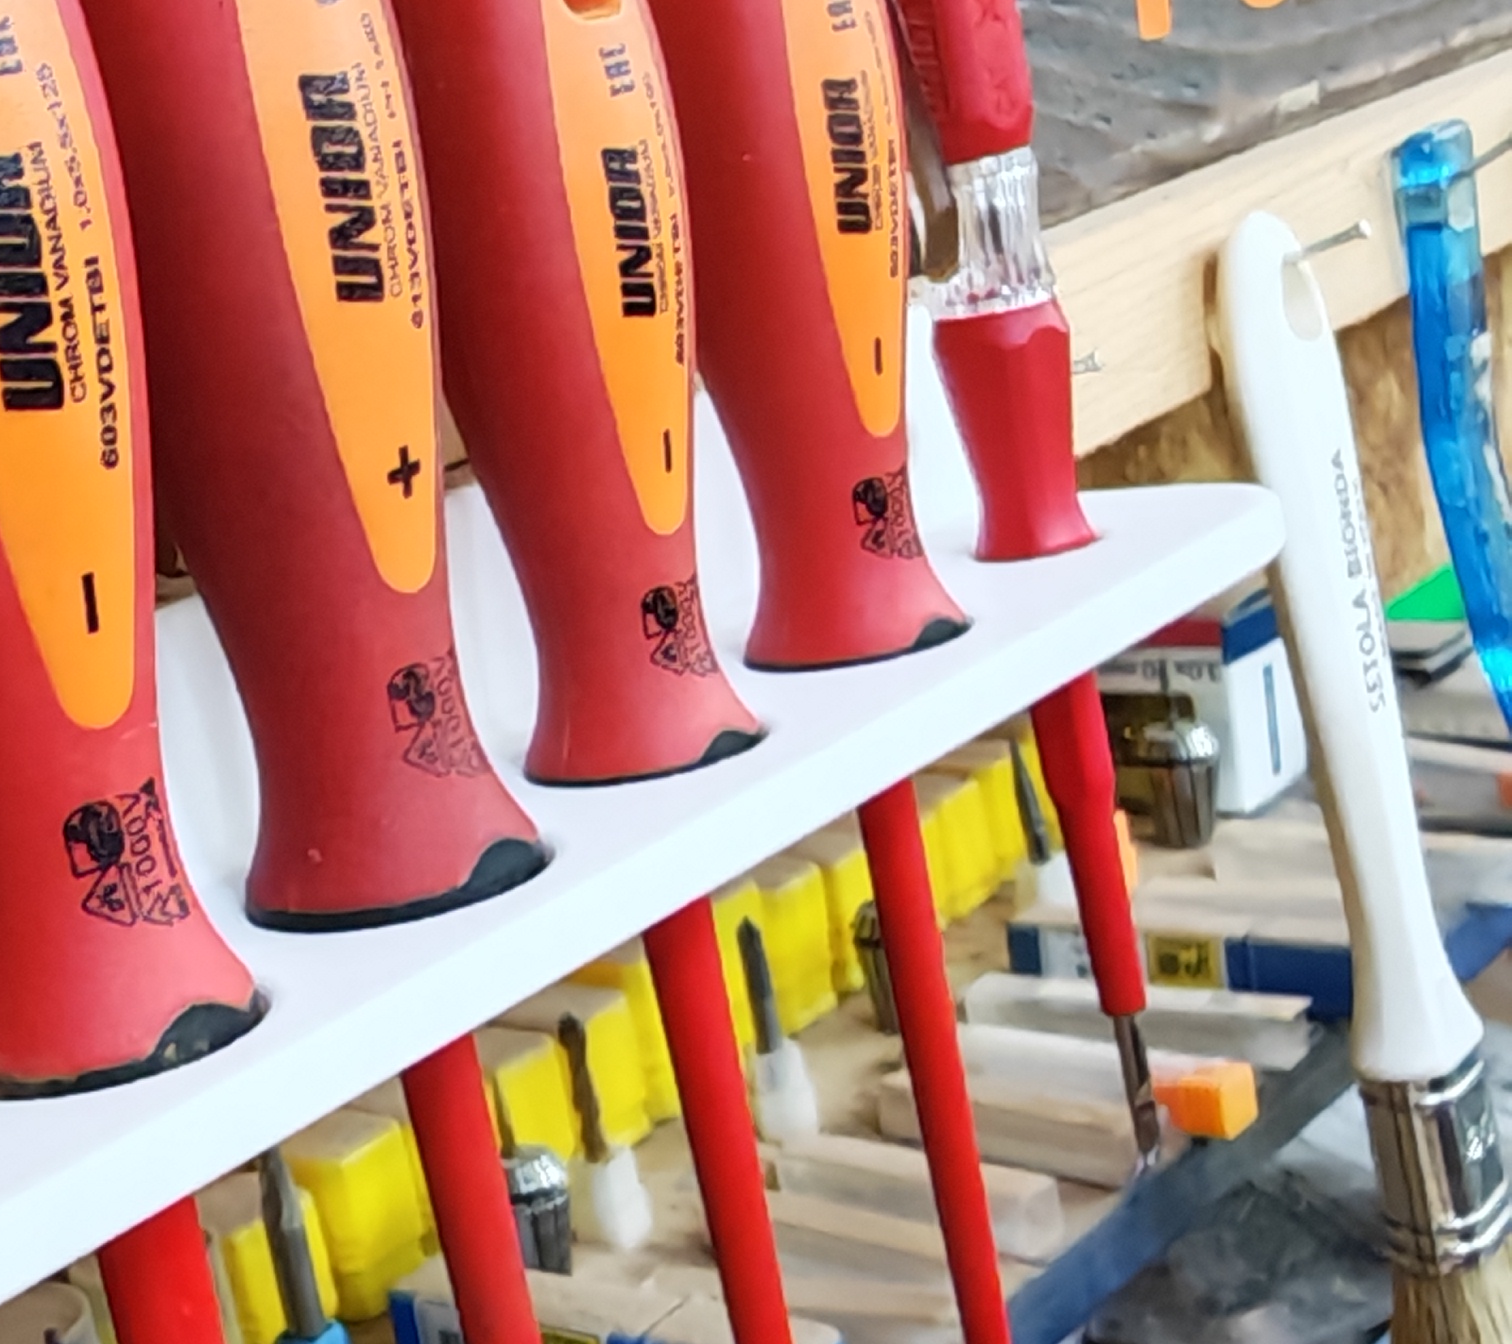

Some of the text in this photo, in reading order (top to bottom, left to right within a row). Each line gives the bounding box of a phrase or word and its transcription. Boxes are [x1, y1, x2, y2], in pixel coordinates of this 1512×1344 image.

[298, 71, 384, 303] UNIOR
[601, 147, 656, 318] UNIOR
[821, 78, 872, 235] UNIOR
[26, 142, 86, 404] CHROM VANADIUM
[85, 256, 119, 470] 603VDETBI
[114, 793, 162, 895] 1000V
